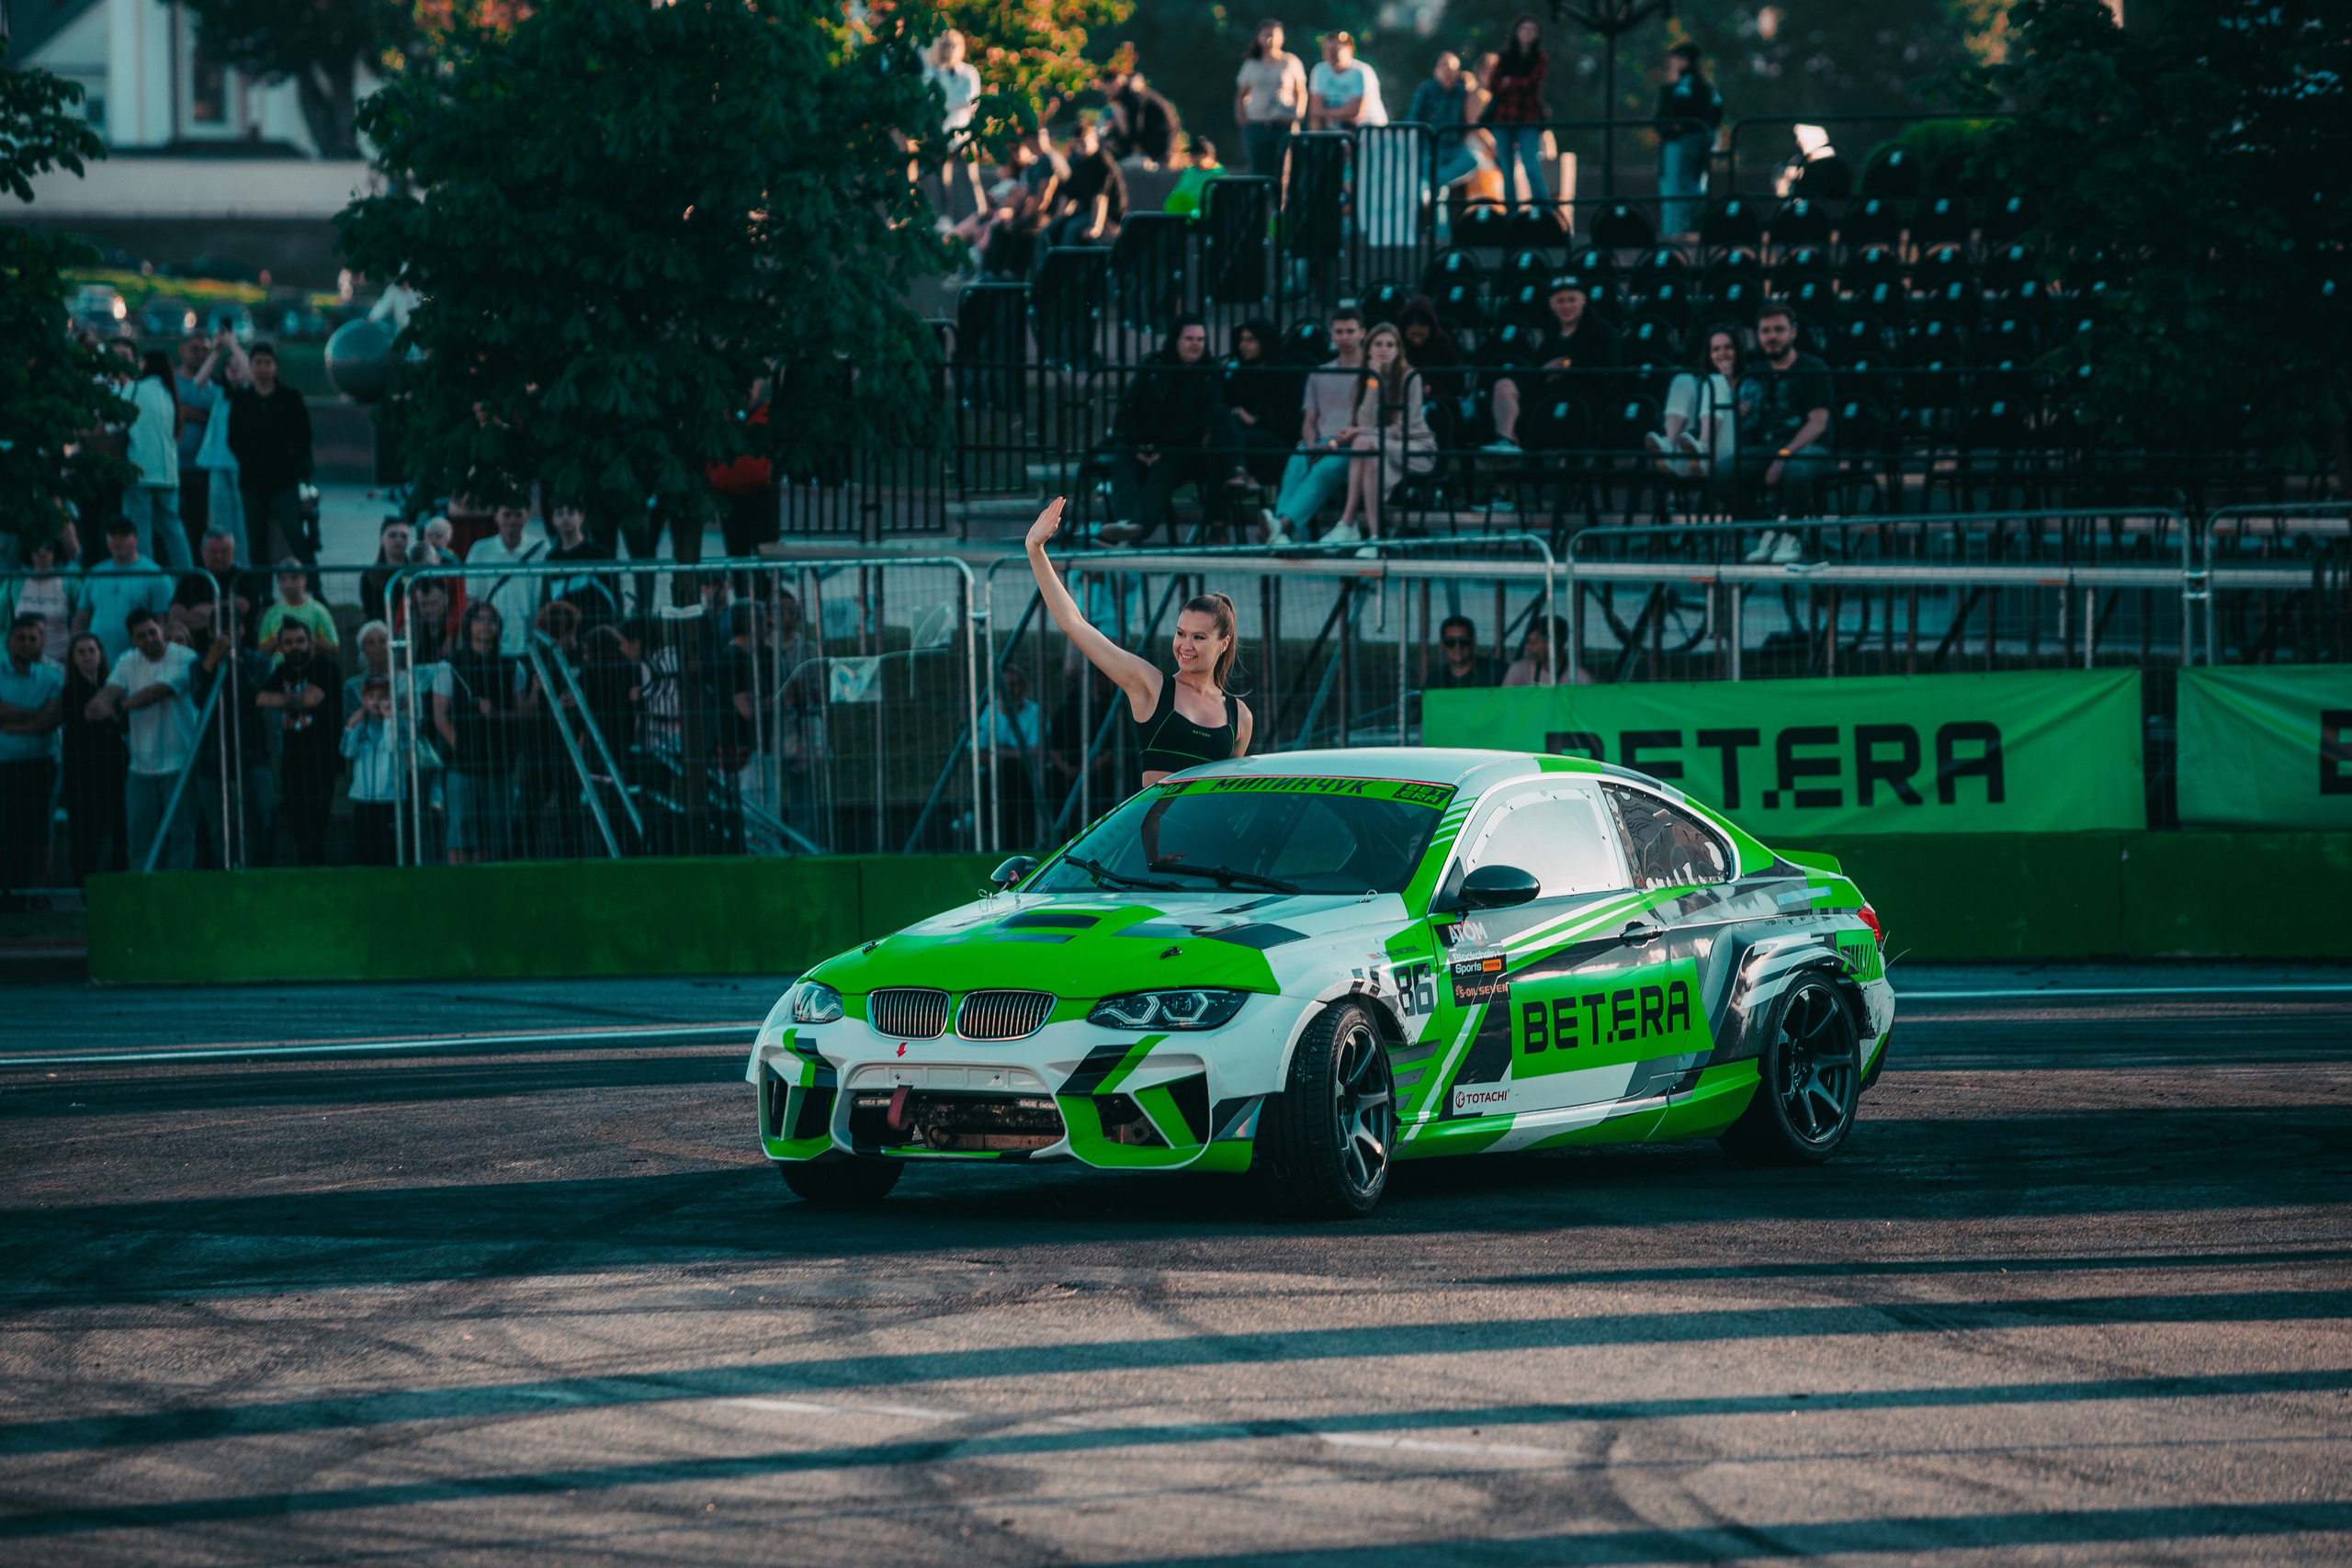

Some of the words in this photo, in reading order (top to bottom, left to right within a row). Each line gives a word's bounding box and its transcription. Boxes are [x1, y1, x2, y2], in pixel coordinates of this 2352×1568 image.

[1209, 777, 1373, 795] МИЛИНЧУК
[1406, 784, 1447, 796] BET
[1448, 921, 1488, 943] ATOM
[1455, 961, 1482, 975] Sports
[1394, 964, 1434, 1017] 86
[1478, 982, 1509, 995] SEVEN
[1522, 980, 1690, 1055] BET.ERA
[1466, 1089, 1508, 1104] TOTACHI
